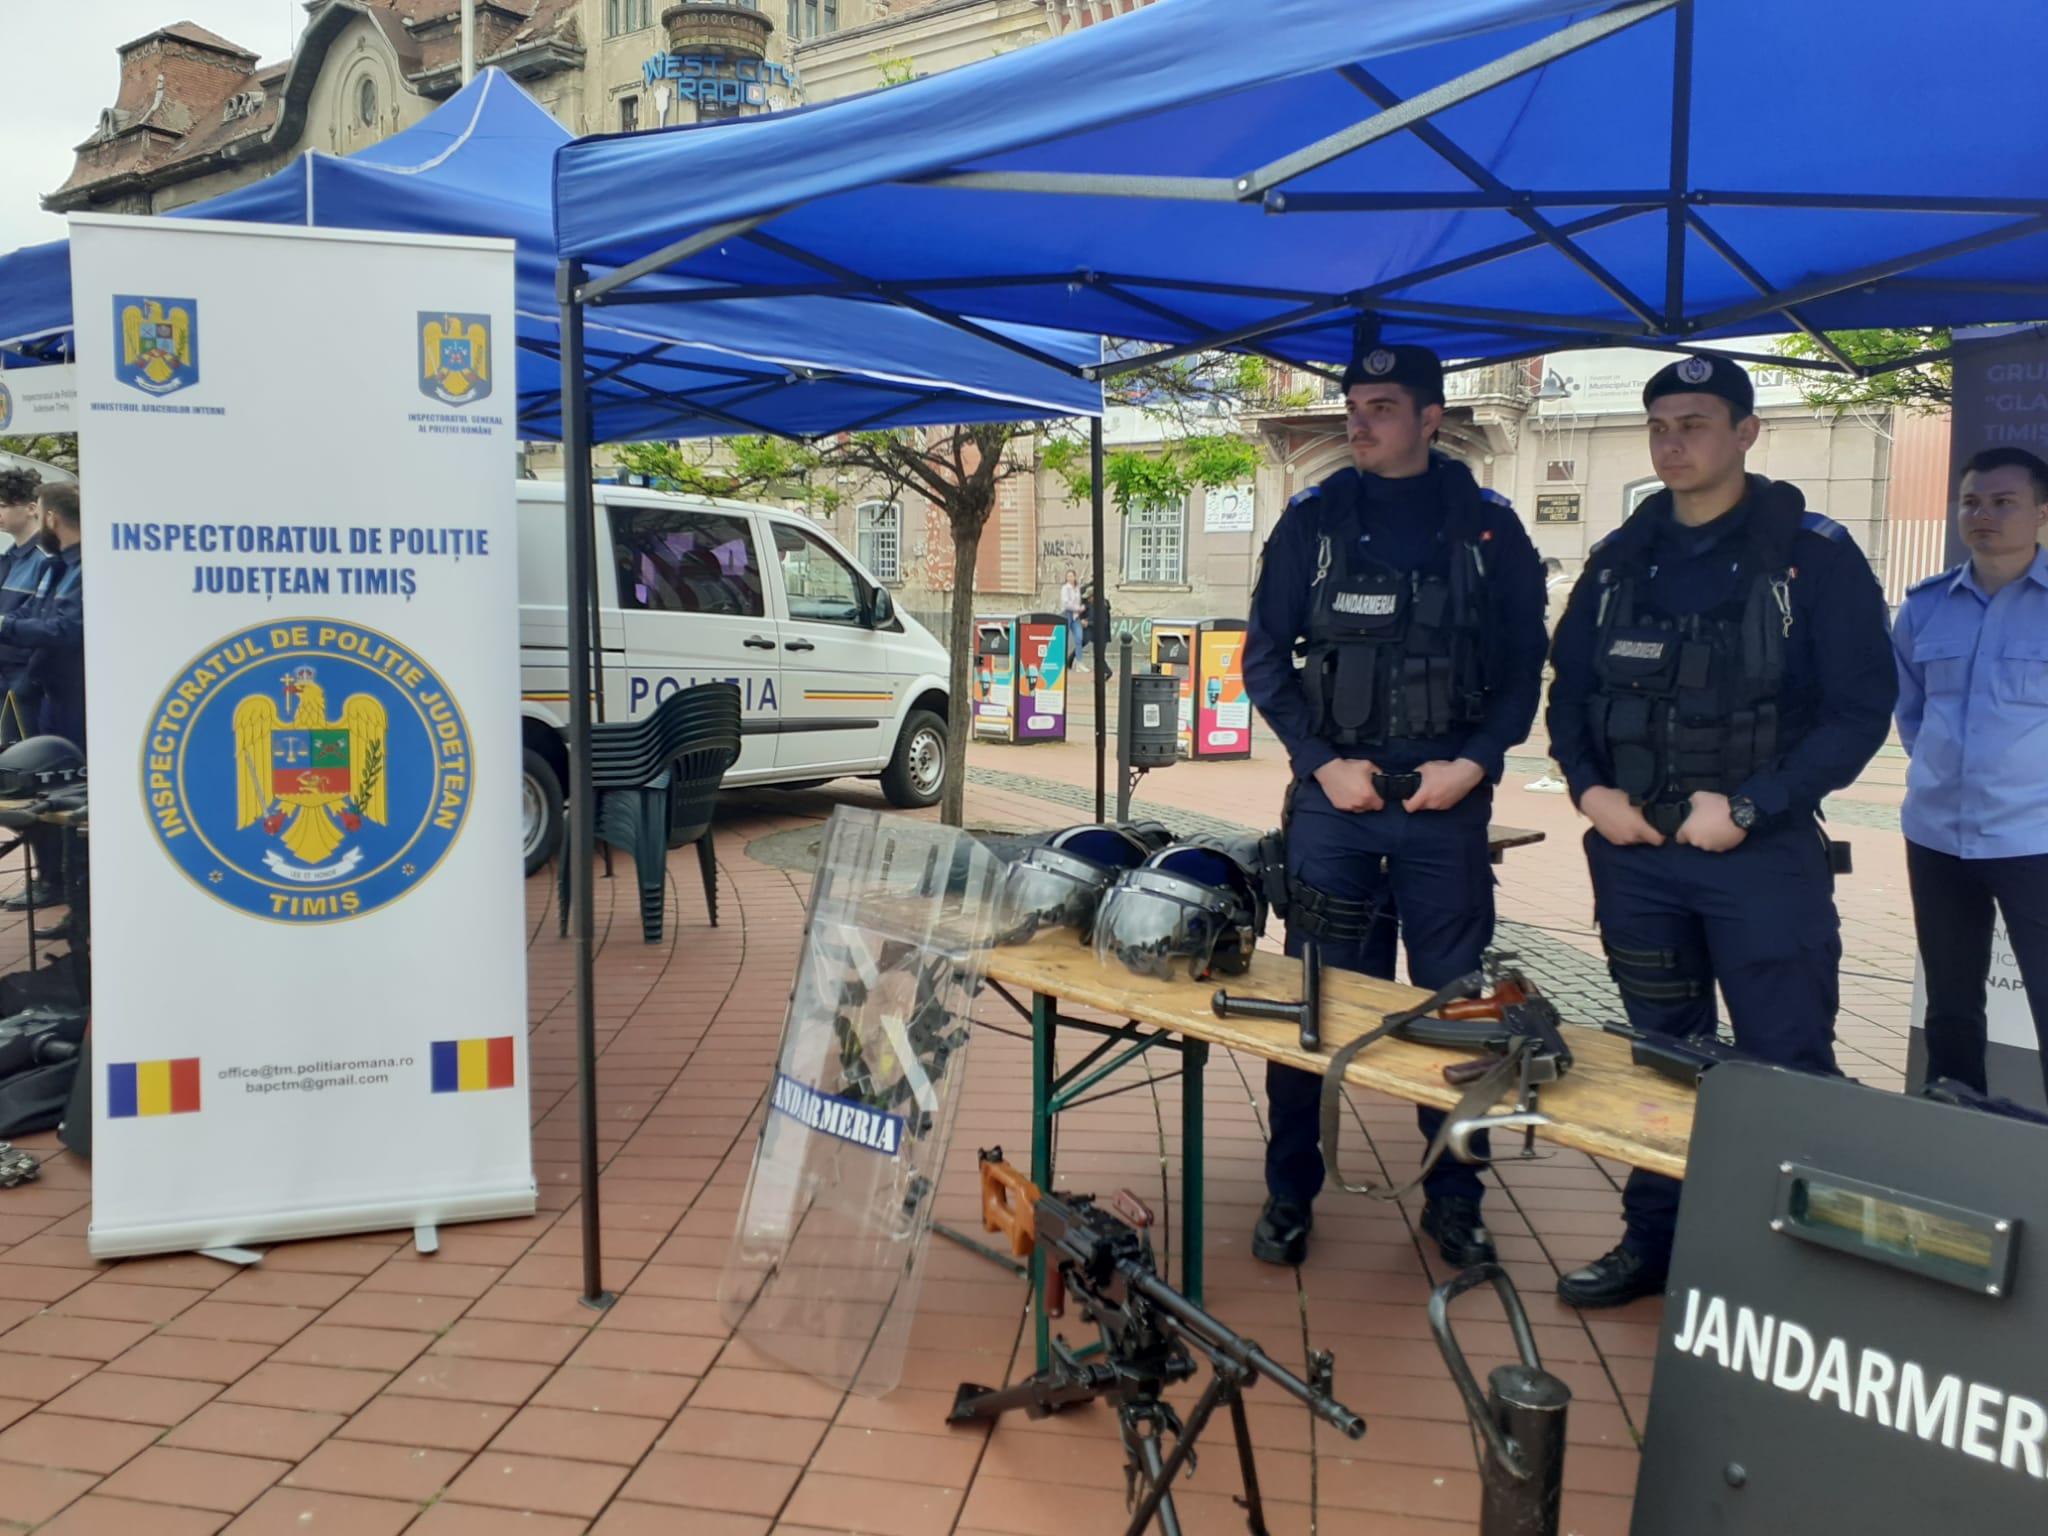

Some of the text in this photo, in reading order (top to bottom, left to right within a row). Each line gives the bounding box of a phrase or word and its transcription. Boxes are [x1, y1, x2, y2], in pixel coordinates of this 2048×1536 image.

[643, 50, 797, 88] WEST CITY
[677, 78, 766, 106] RADIO
[1986, 363, 2048, 383] GRU
[90, 402, 139, 412] MINISTERUL
[192, 406, 225, 415] INTERNE
[408, 413, 504, 425] INSPECTORATUL GENERAL
[111, 523, 489, 562] INSPECTORATUL DE POLIȚIE
[192, 566, 417, 602] JUDEȚEAN TIMIȘ
[1332, 592, 1397, 615] JANDARMERIA
[630, 676, 778, 714] POIA
[151, 626, 466, 838] INSPECTORATUL DE POLIȚIE JUDEȚEAN
[269, 890, 360, 916] TIMIȘ
[218, 1055, 414, 1080] office@tm.politiaromana.ro
[246, 1073, 389, 1094] bapctm@gmail.com
[771, 1076, 896, 1153] ANDARMERIA
[1674, 1288, 2048, 1479] JANDARMER
